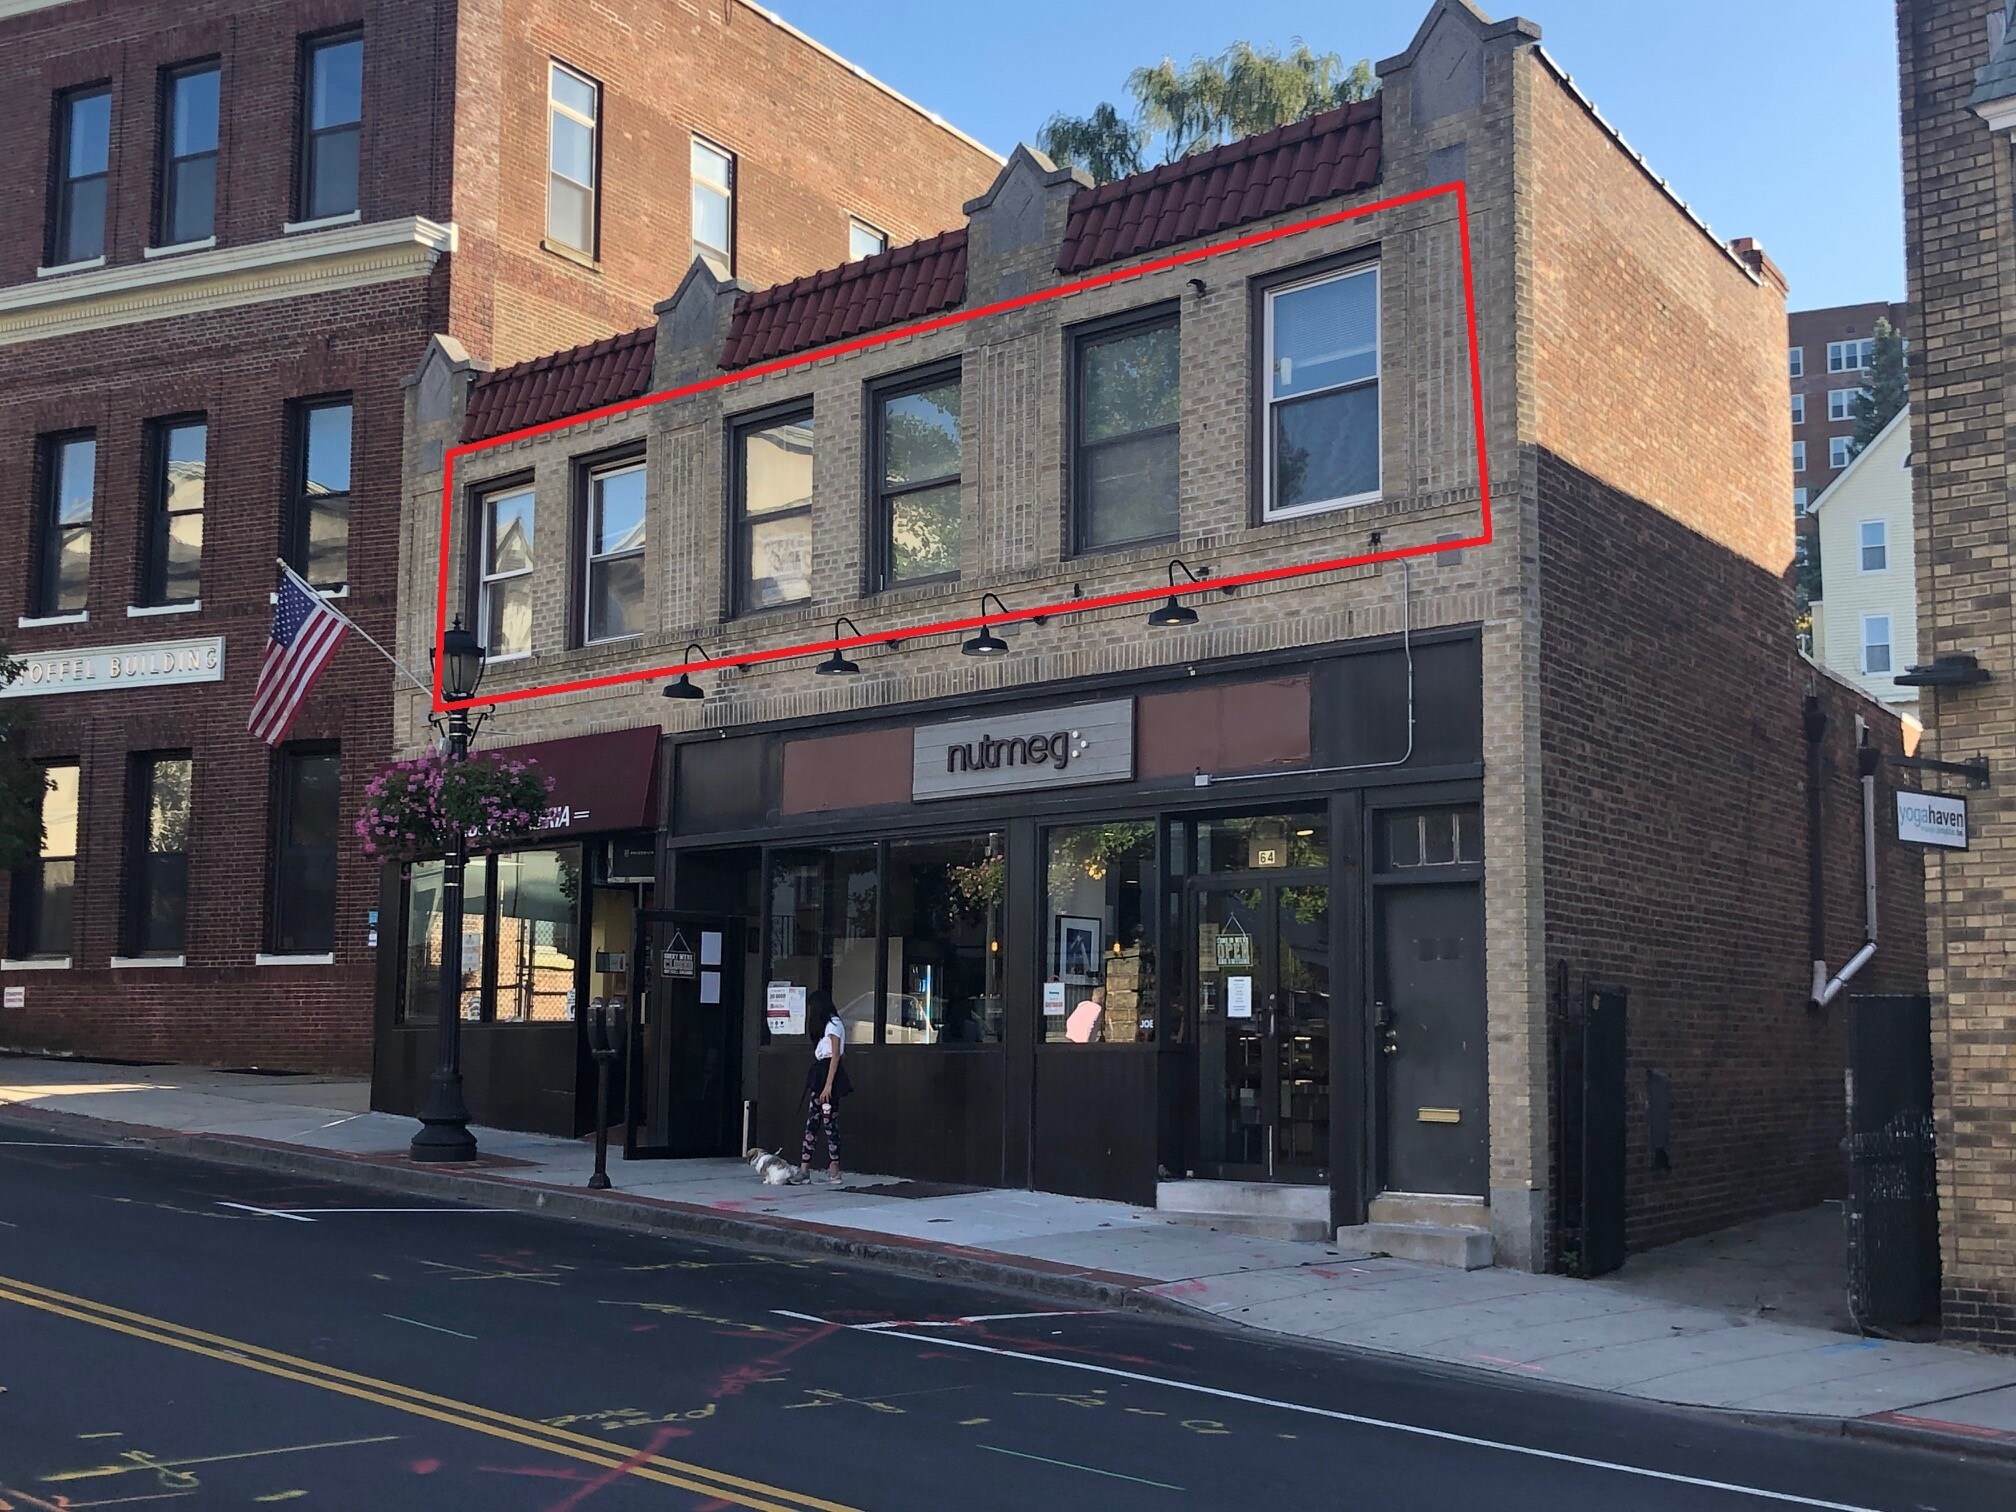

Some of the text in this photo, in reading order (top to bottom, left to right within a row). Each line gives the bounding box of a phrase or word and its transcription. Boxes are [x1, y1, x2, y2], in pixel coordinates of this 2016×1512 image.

[110, 648, 217, 678] BUILDING
[947, 731, 1069, 773] nutmeg
[1899, 804, 1964, 828] yogahaven
[1260, 851, 1274, 864] 64
